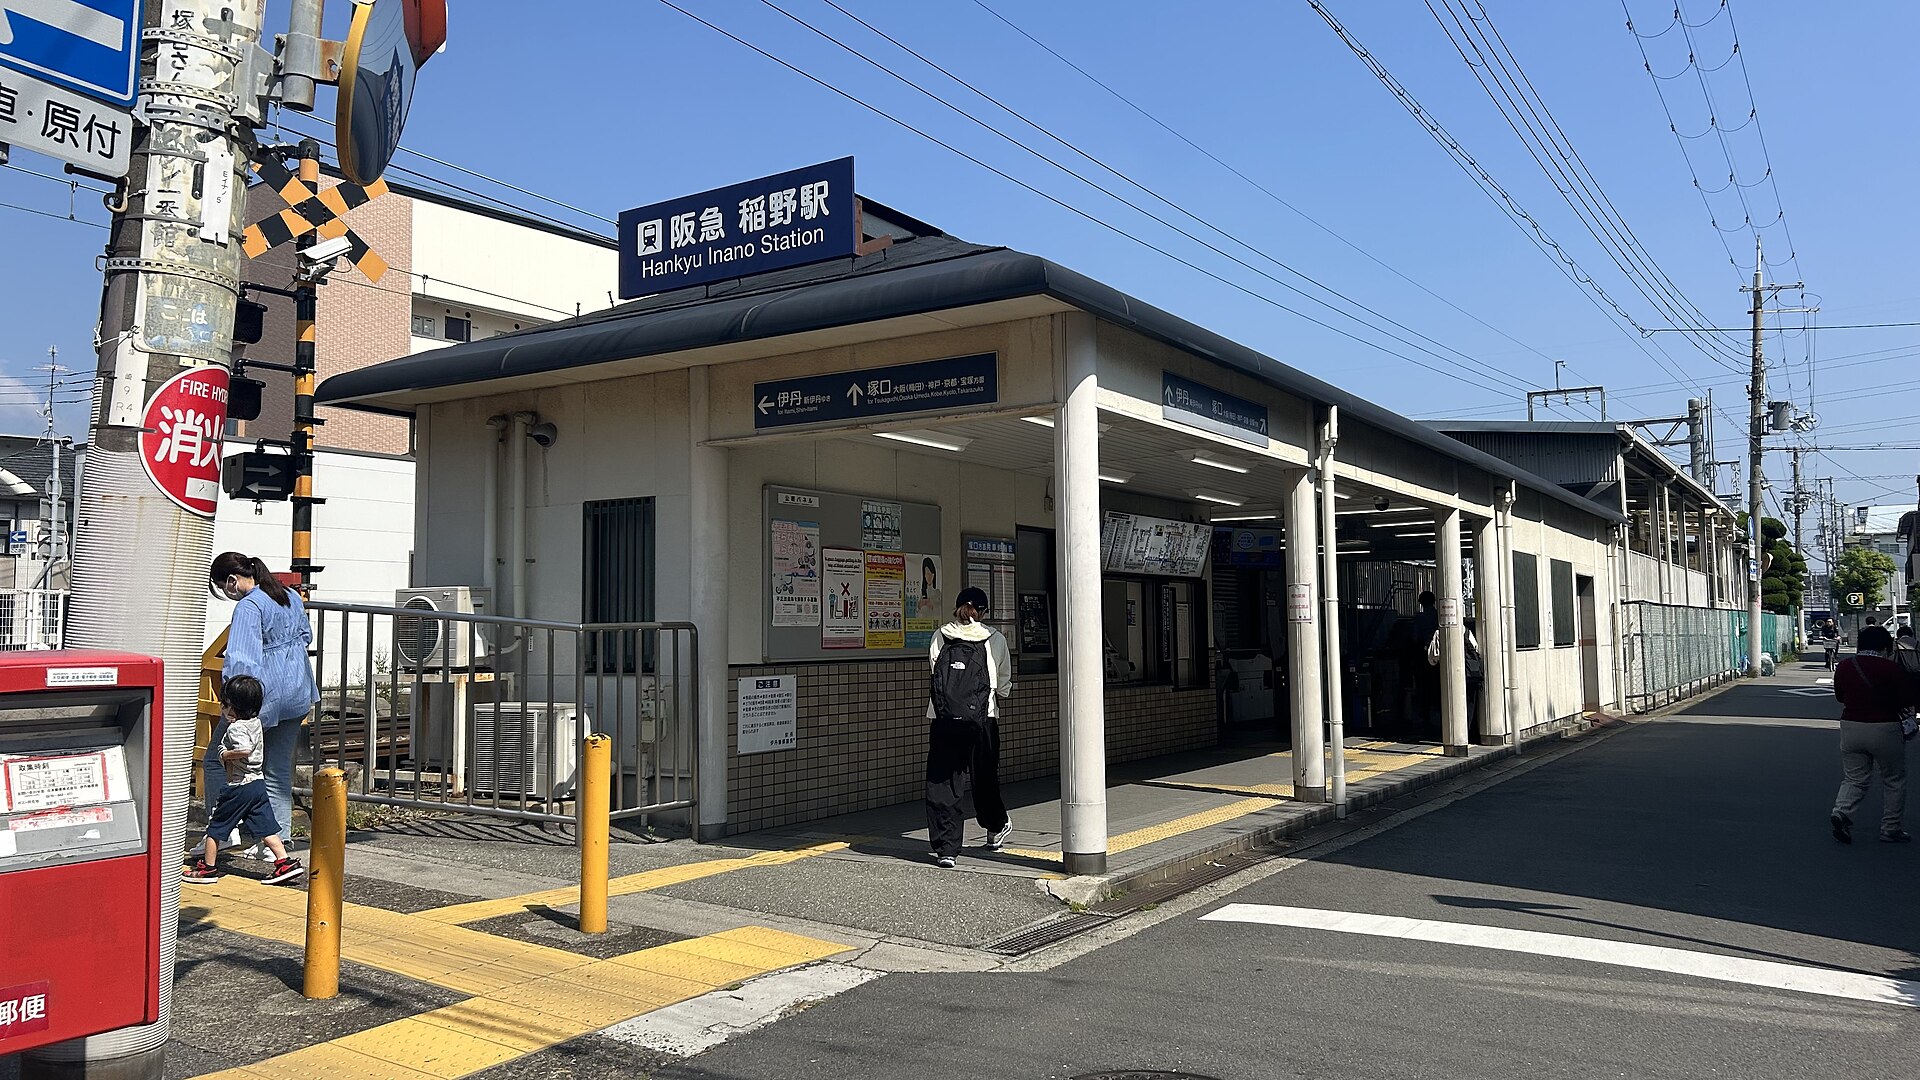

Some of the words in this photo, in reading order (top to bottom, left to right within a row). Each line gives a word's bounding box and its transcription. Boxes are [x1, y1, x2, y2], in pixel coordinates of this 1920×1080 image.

[670, 206, 726, 250] 阪急
[739, 180, 829, 234] 稲野駅
[642, 254, 702, 279] Hankyu
[708, 243, 755, 265] Inano
[761, 227, 824, 254] Station
[123, 385, 131, 395] 9
[179, 378, 210, 399] FIRE
[867, 379, 891, 397] 塚口
[777, 390, 802, 408] 伊丹
[18, 762, 50, 772] 取集時刻
[0, 994, 46, 1026] 郵便
